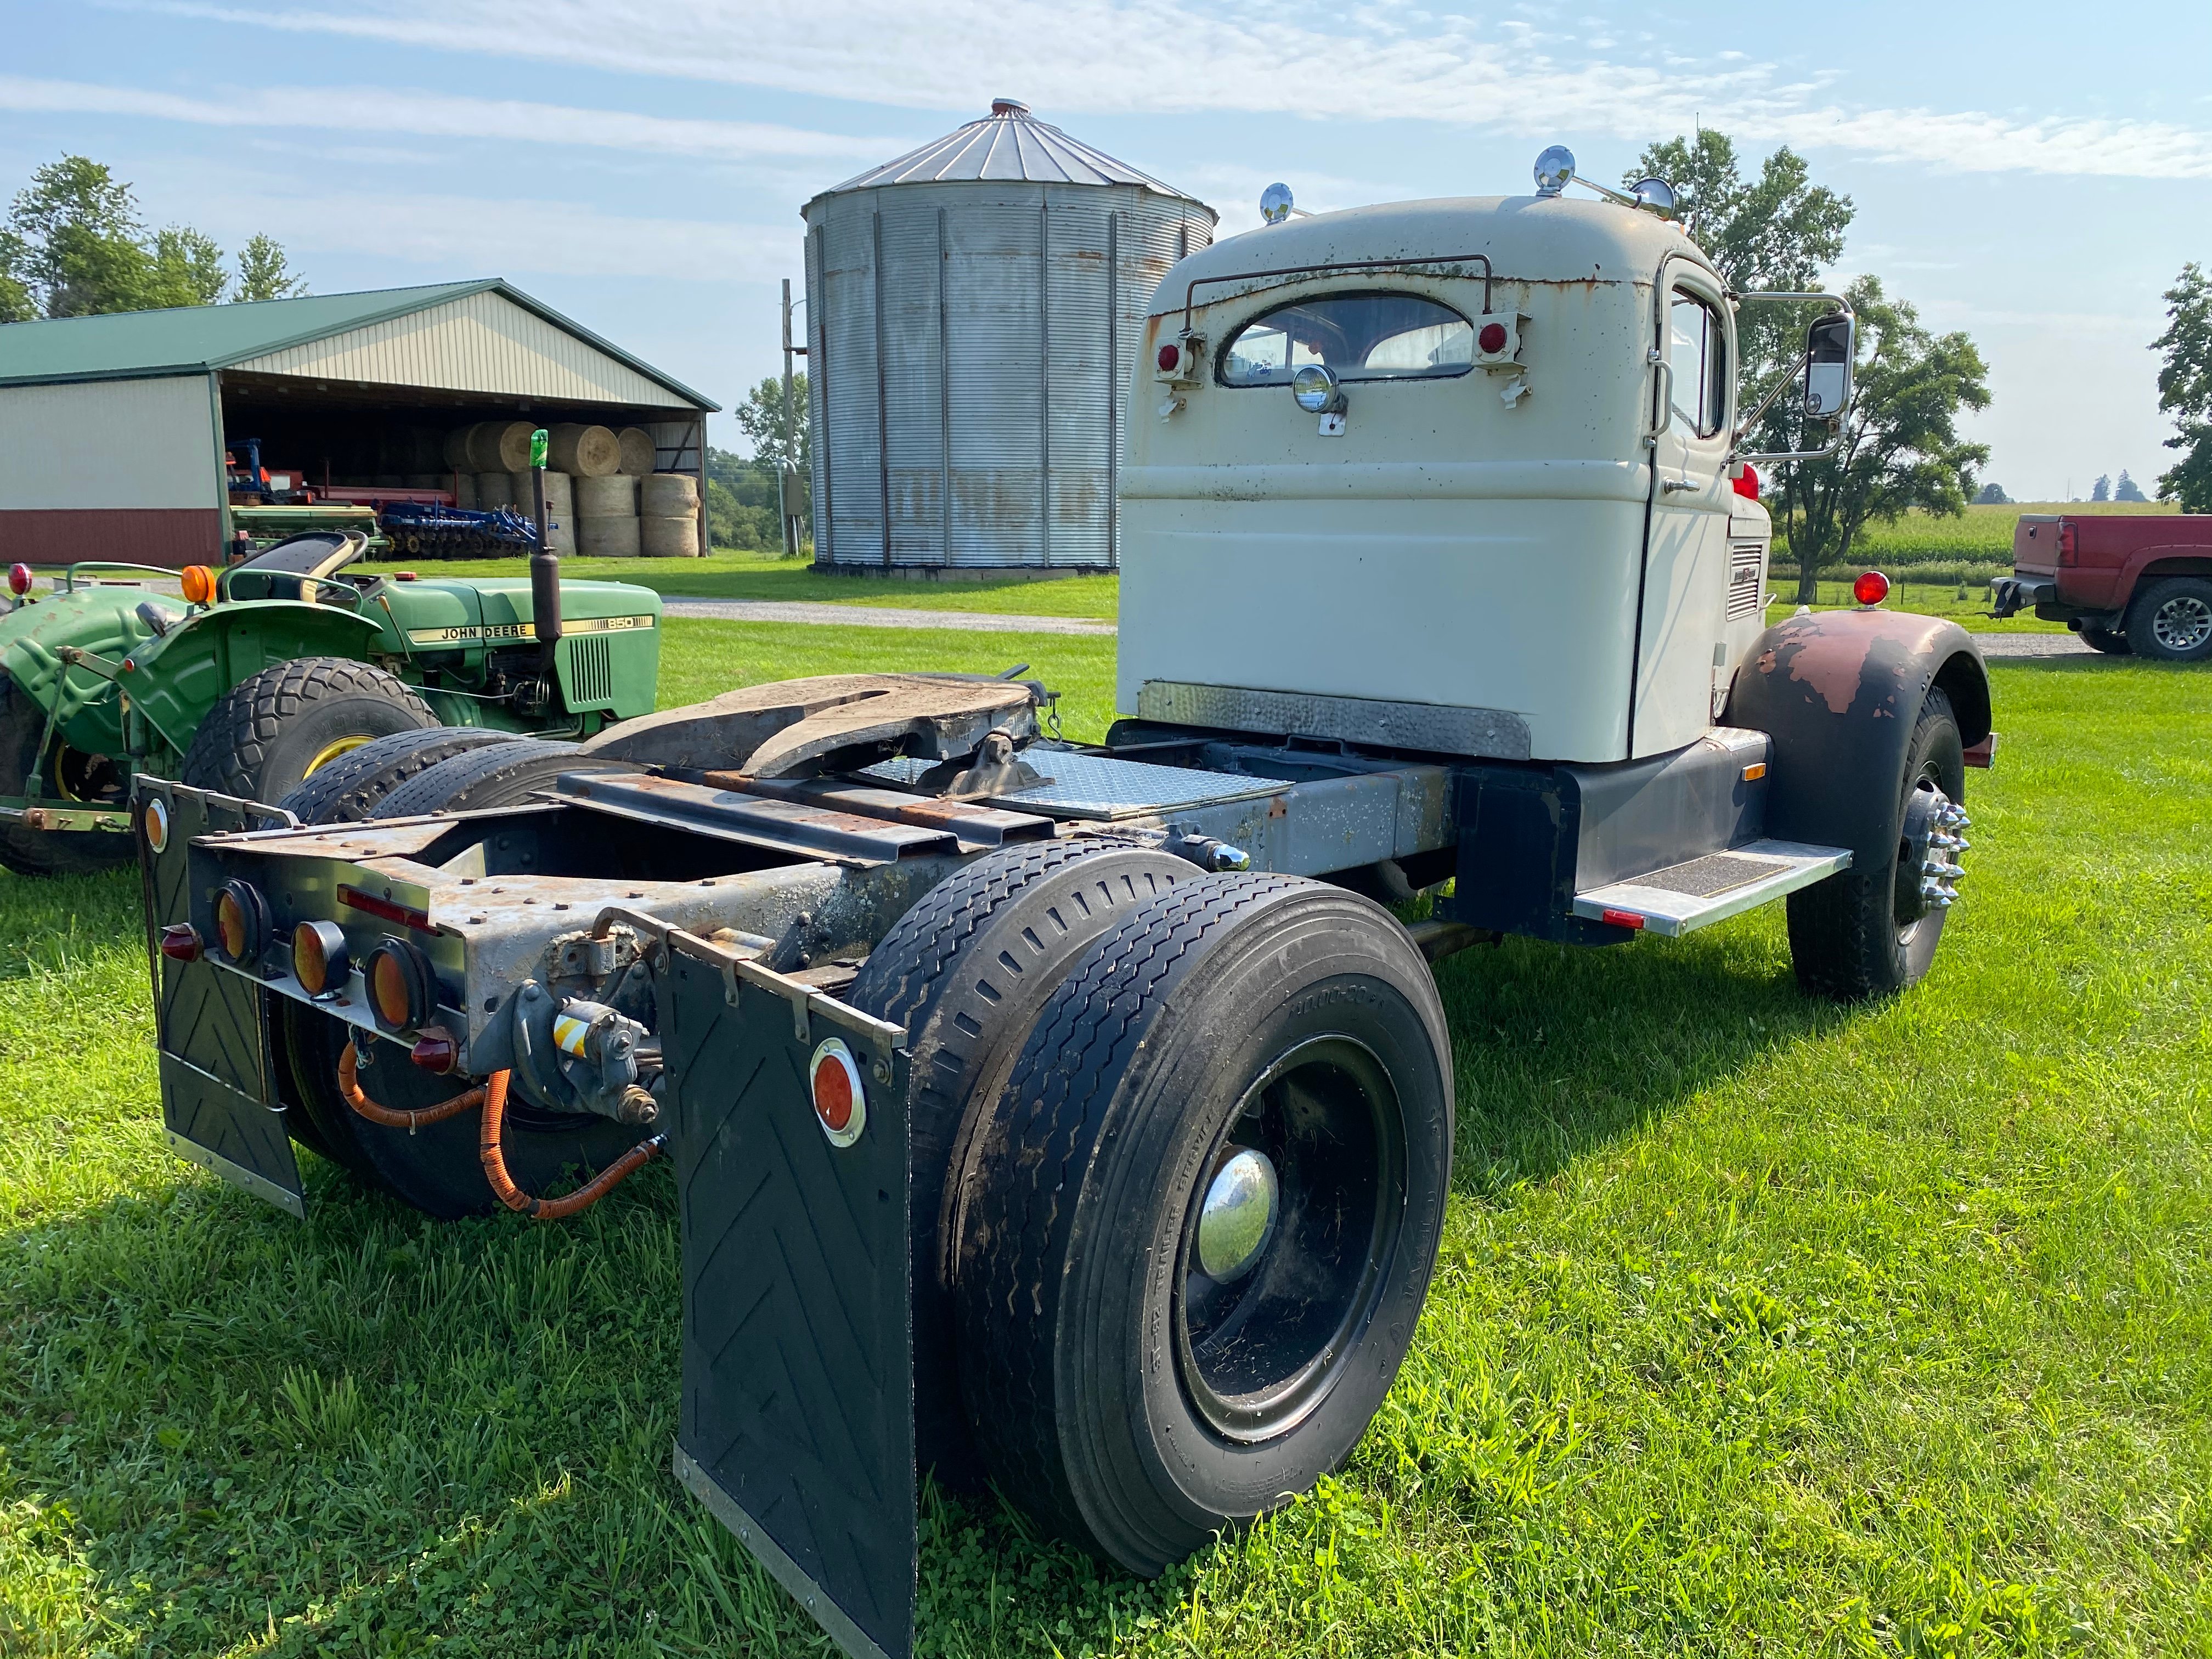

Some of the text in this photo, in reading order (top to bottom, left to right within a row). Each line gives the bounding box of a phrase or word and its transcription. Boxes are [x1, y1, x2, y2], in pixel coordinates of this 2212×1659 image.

[608, 617, 634, 629] 850
[442, 625, 527, 639] JOHN DEERE
